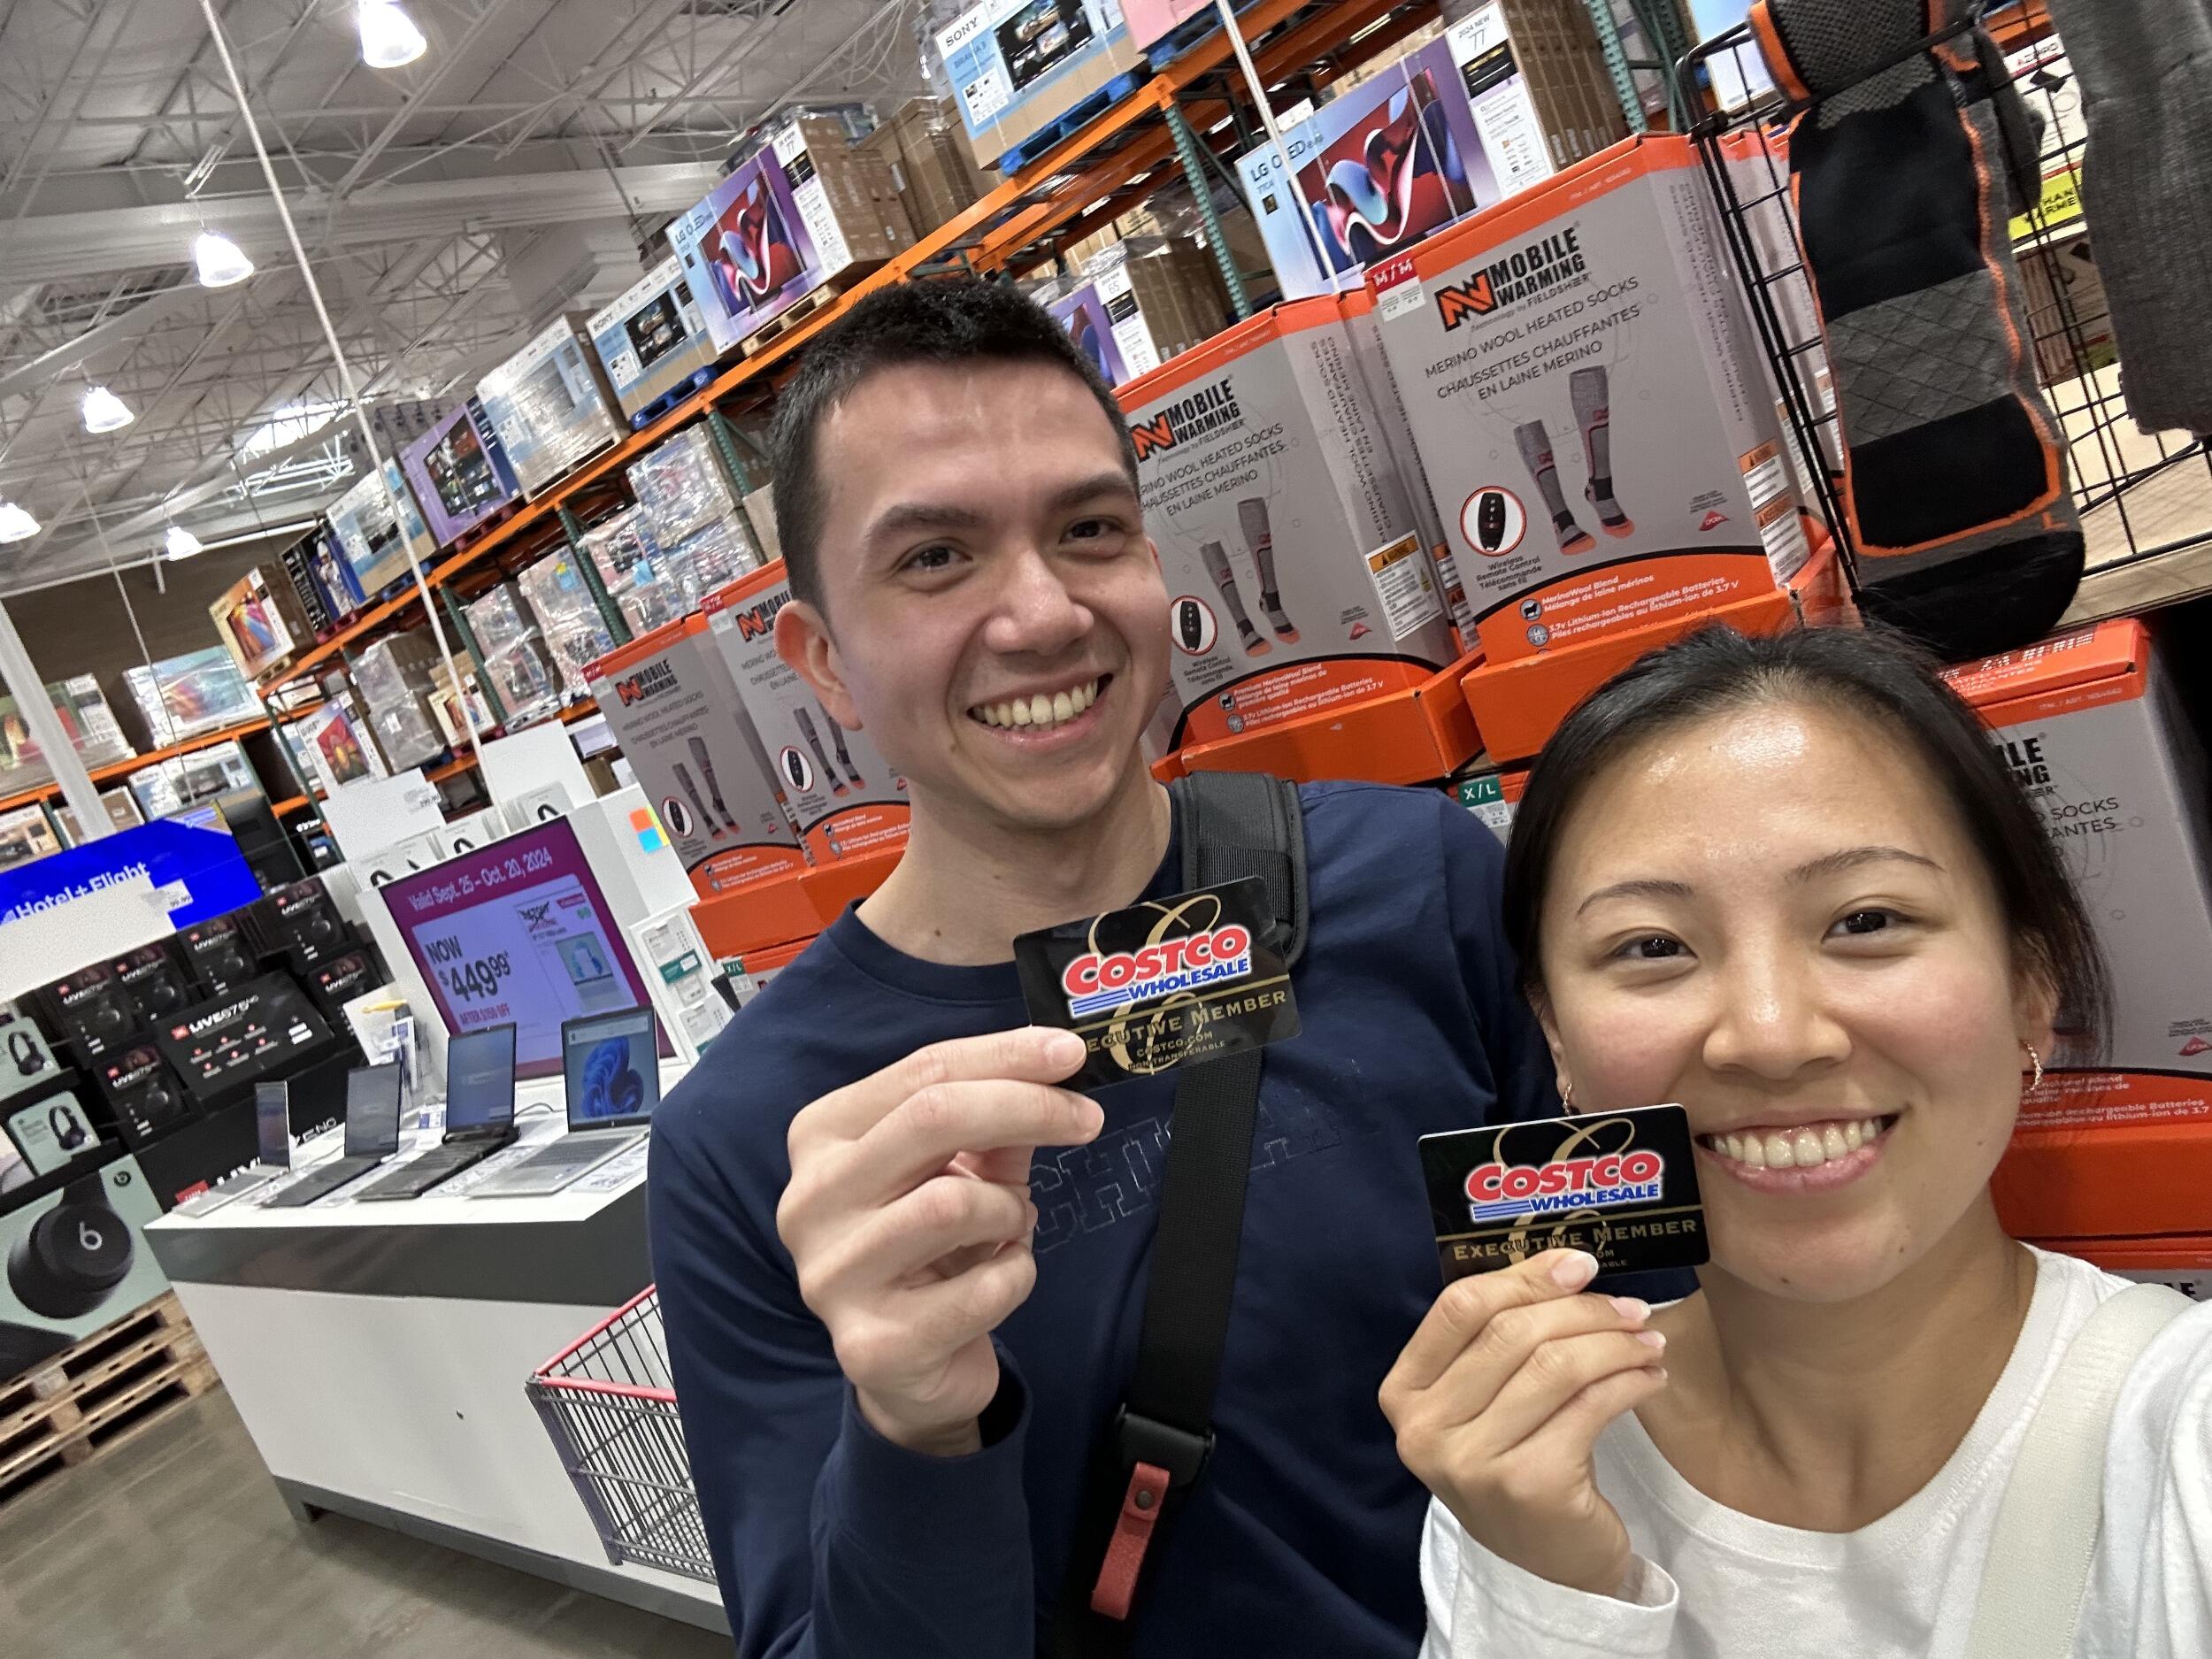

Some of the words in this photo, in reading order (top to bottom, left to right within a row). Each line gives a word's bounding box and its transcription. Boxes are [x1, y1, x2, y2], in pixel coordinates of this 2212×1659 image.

[946, 18, 978, 47] SONY
[1474, 13, 1490, 27] NEW
[1250, 162, 1269, 182] LG
[1271, 140, 1306, 169] OED
[1488, 227, 1580, 289] MOBILE
[1496, 252, 1586, 307] WARMING
[1425, 347, 1478, 379] MERINO
[1479, 327, 1525, 353] WOOL
[1525, 300, 1584, 334] HEATED
[1587, 275, 1640, 307] SOCKS
[1310, 341, 1331, 387] SOCKS
[1437, 350, 1531, 399] CHAUSSETTES
[1532, 303, 1641, 358] CHAUFFANTES
[1479, 384, 1498, 400] EN
[1502, 365, 1541, 391] LAINE
[1544, 340, 1603, 373] MERINO
[1167, 379, 1235, 426] MOBILE
[1174, 401, 1240, 445] WARMING
[1327, 388, 1351, 443] HEATED
[1140, 476, 1165, 496] RINO
[1165, 463, 1200, 483] WOOL
[1200, 443, 1243, 468] HEATED
[1244, 422, 1284, 449] SOCKS
[1141, 476, 1204, 510] HAUSSETTES
[1204, 440, 1286, 483] CHAUFFANTES
[1348, 449, 1366, 488] WOOL
[1166, 502, 1181, 517] EN
[1183, 488, 1214, 511] LAINE
[1214, 469, 1258, 495] MERINO
[1364, 490, 1387, 544] MERINO
[1463, 783, 1496, 801] X/L
[2050, 797, 2120, 821] SOCKS
[408, 891, 434, 911] Valid
[458, 875, 474, 895] 25
[481, 866, 506, 887] Oct.
[523, 847, 553, 872] 2024
[15, 886, 75, 920] Hotel
[425, 934, 464, 965] NOW
[1064, 925, 1251, 996] COSTCO
[1127, 956, 1250, 1002] WHOLESALE
[1087, 1013, 1183, 1053] ECUTIVE
[1190, 989, 1287, 1028] MEMBER
[2149, 1098, 2205, 1110] Batteries
[2174, 1107, 2189, 1116] de
[2191, 1105, 2209, 1116] 3.7
[1466, 1151, 1663, 1202] COSTCO
[1531, 1184, 1660, 1212] WHOLESALE
[1454, 1232, 1583, 1261] EXECUTIVE
[1594, 1219, 1698, 1242] MEMBER
